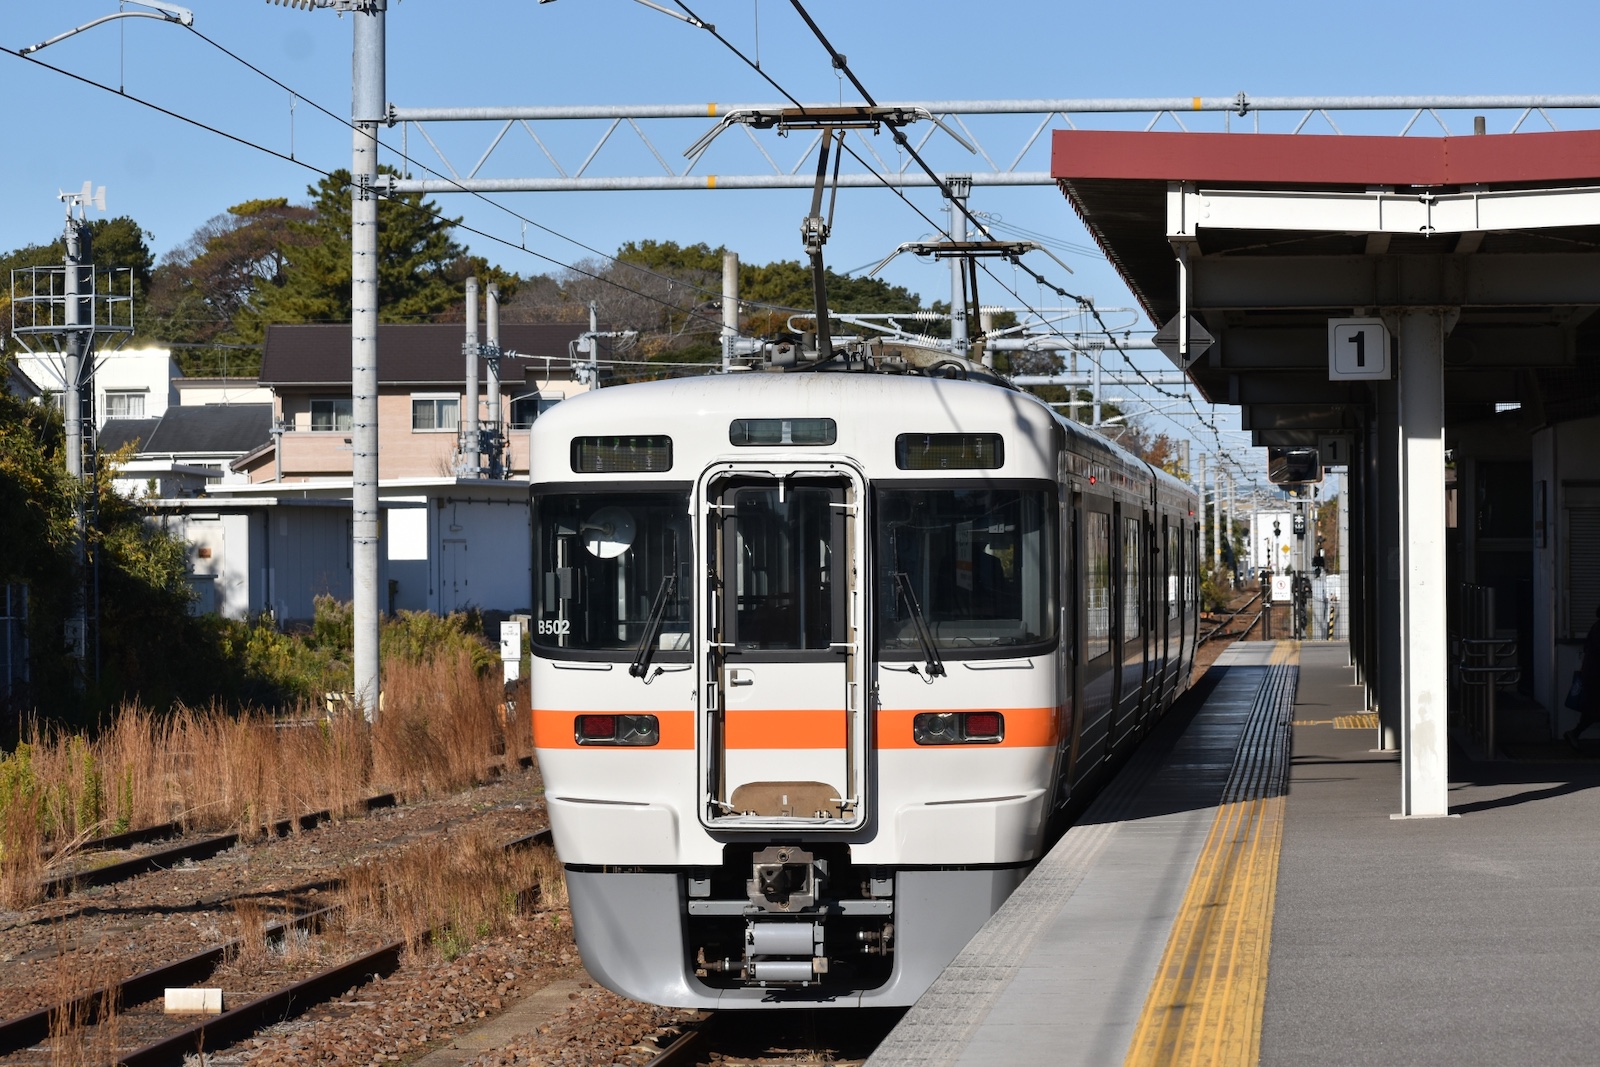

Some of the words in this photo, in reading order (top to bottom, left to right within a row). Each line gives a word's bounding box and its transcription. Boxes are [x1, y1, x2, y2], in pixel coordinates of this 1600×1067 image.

[1348, 331, 1365, 367] 1
[1328, 441, 1337, 460] 1
[538, 619, 570, 635] B502
